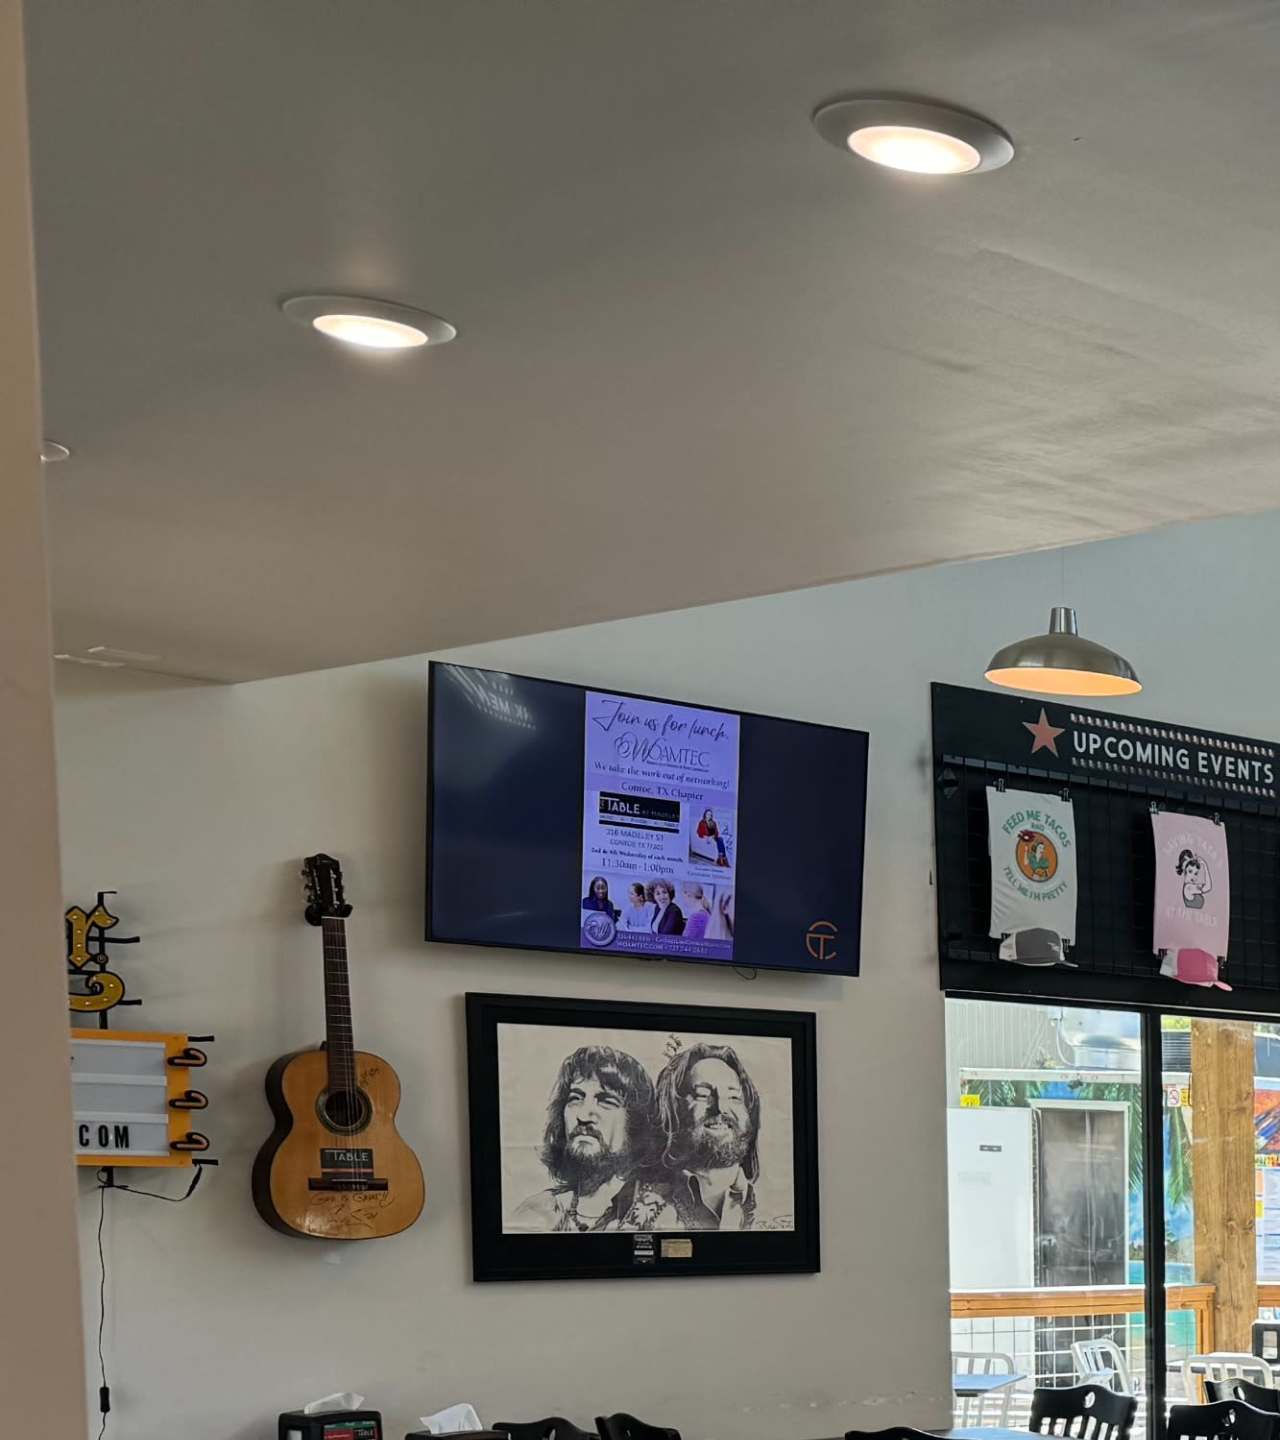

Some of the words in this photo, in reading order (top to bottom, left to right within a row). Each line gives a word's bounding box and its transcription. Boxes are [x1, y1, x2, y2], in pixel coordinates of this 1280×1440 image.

[592, 699, 640, 731] Join
[644, 718, 658, 731] us
[661, 714, 687, 736] for
[614, 731, 711, 767] WOAMTEC
[1073, 730, 1190, 770] UPCOMING
[1198, 751, 1275, 784] EVENTS
[627, 765, 639, 775] the
[641, 768, 661, 778] work
[620, 782, 654, 795] Conroe,
[656, 786, 669, 797] TX
[671, 788, 704, 802] Chapter
[605, 797, 640, 815] TABLE
[1001, 811, 1025, 835] FEED
[1026, 810, 1041, 821] ME
[1044, 814, 1071, 848] TACOS
[78, 1124, 130, 1149] COM
[333, 1150, 369, 1162] TABLE
